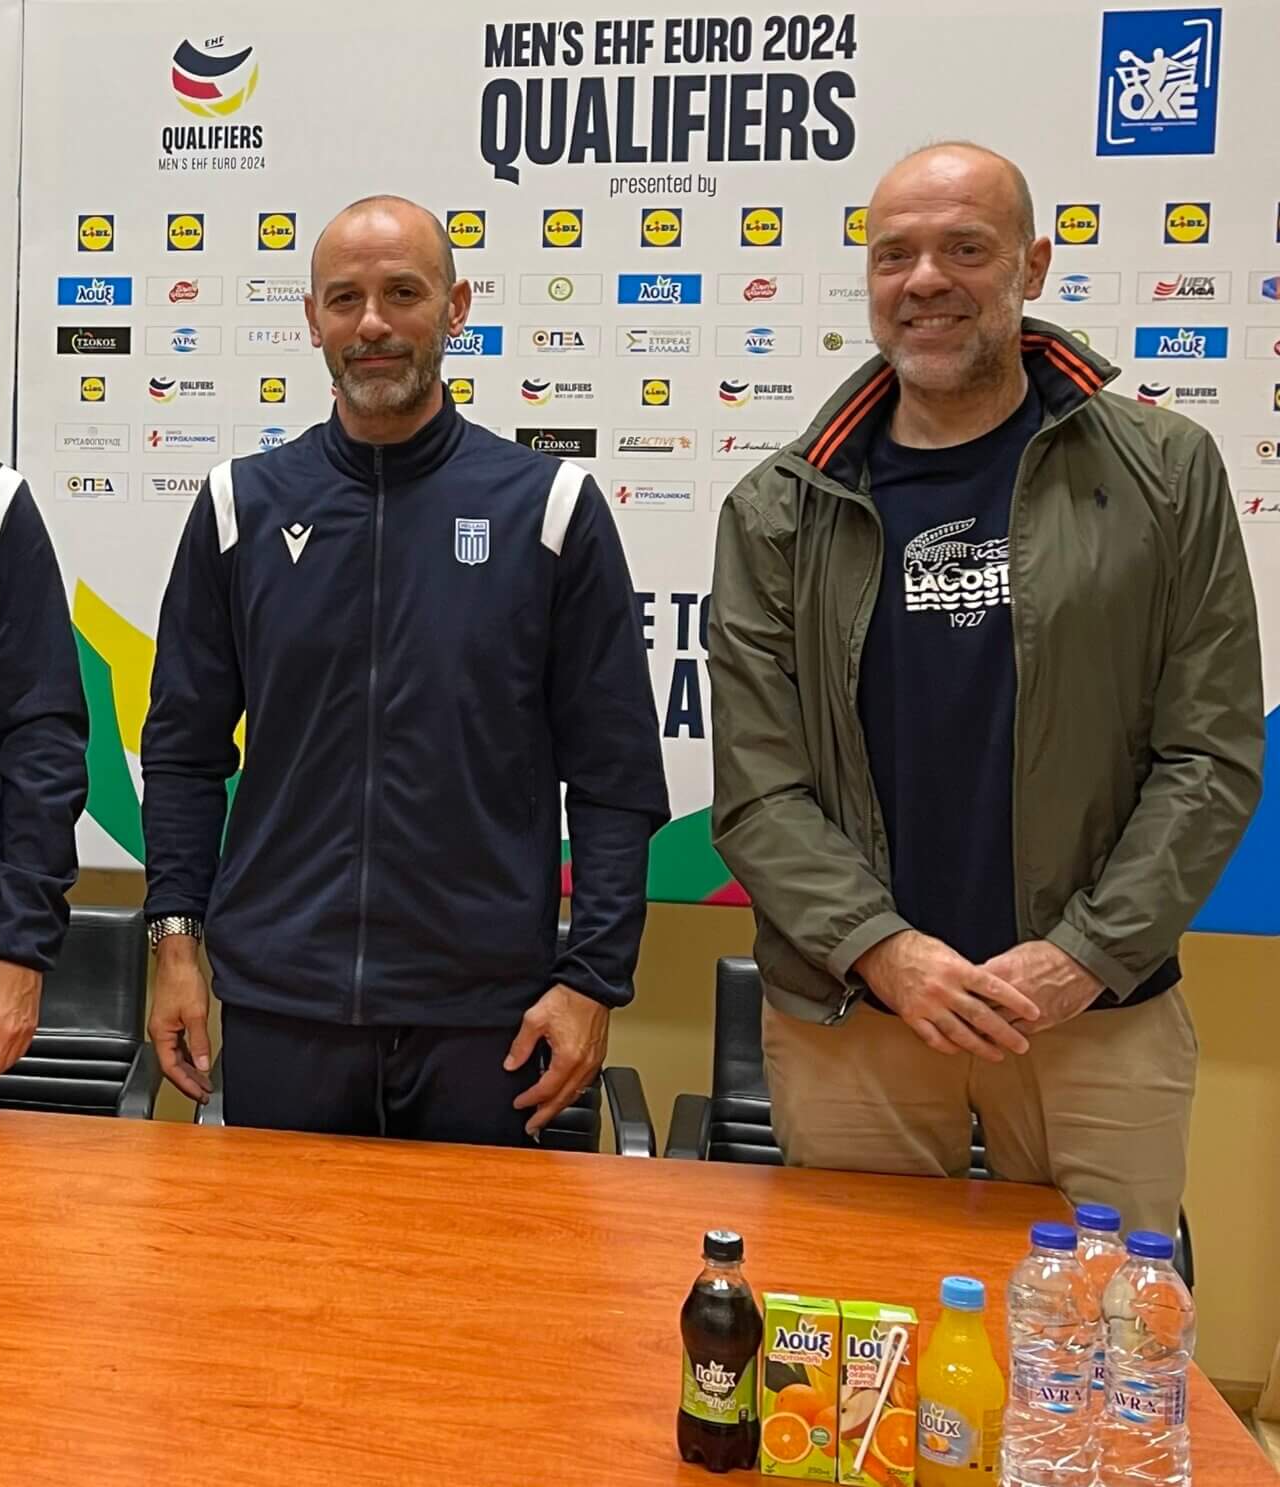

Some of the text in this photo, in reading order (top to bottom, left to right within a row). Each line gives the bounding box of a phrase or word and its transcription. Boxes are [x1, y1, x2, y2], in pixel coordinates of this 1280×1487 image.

[484, 14, 857, 68] MEN'S EHF EURO 2024
[161, 124, 263, 155] QUALIFIERS
[480, 72, 856, 186] QUALIFIERS
[158, 155, 266, 171] MEN'S EHF EURO 2024
[609, 174, 717, 198] presented by
[949, 610, 987, 628] 1927
